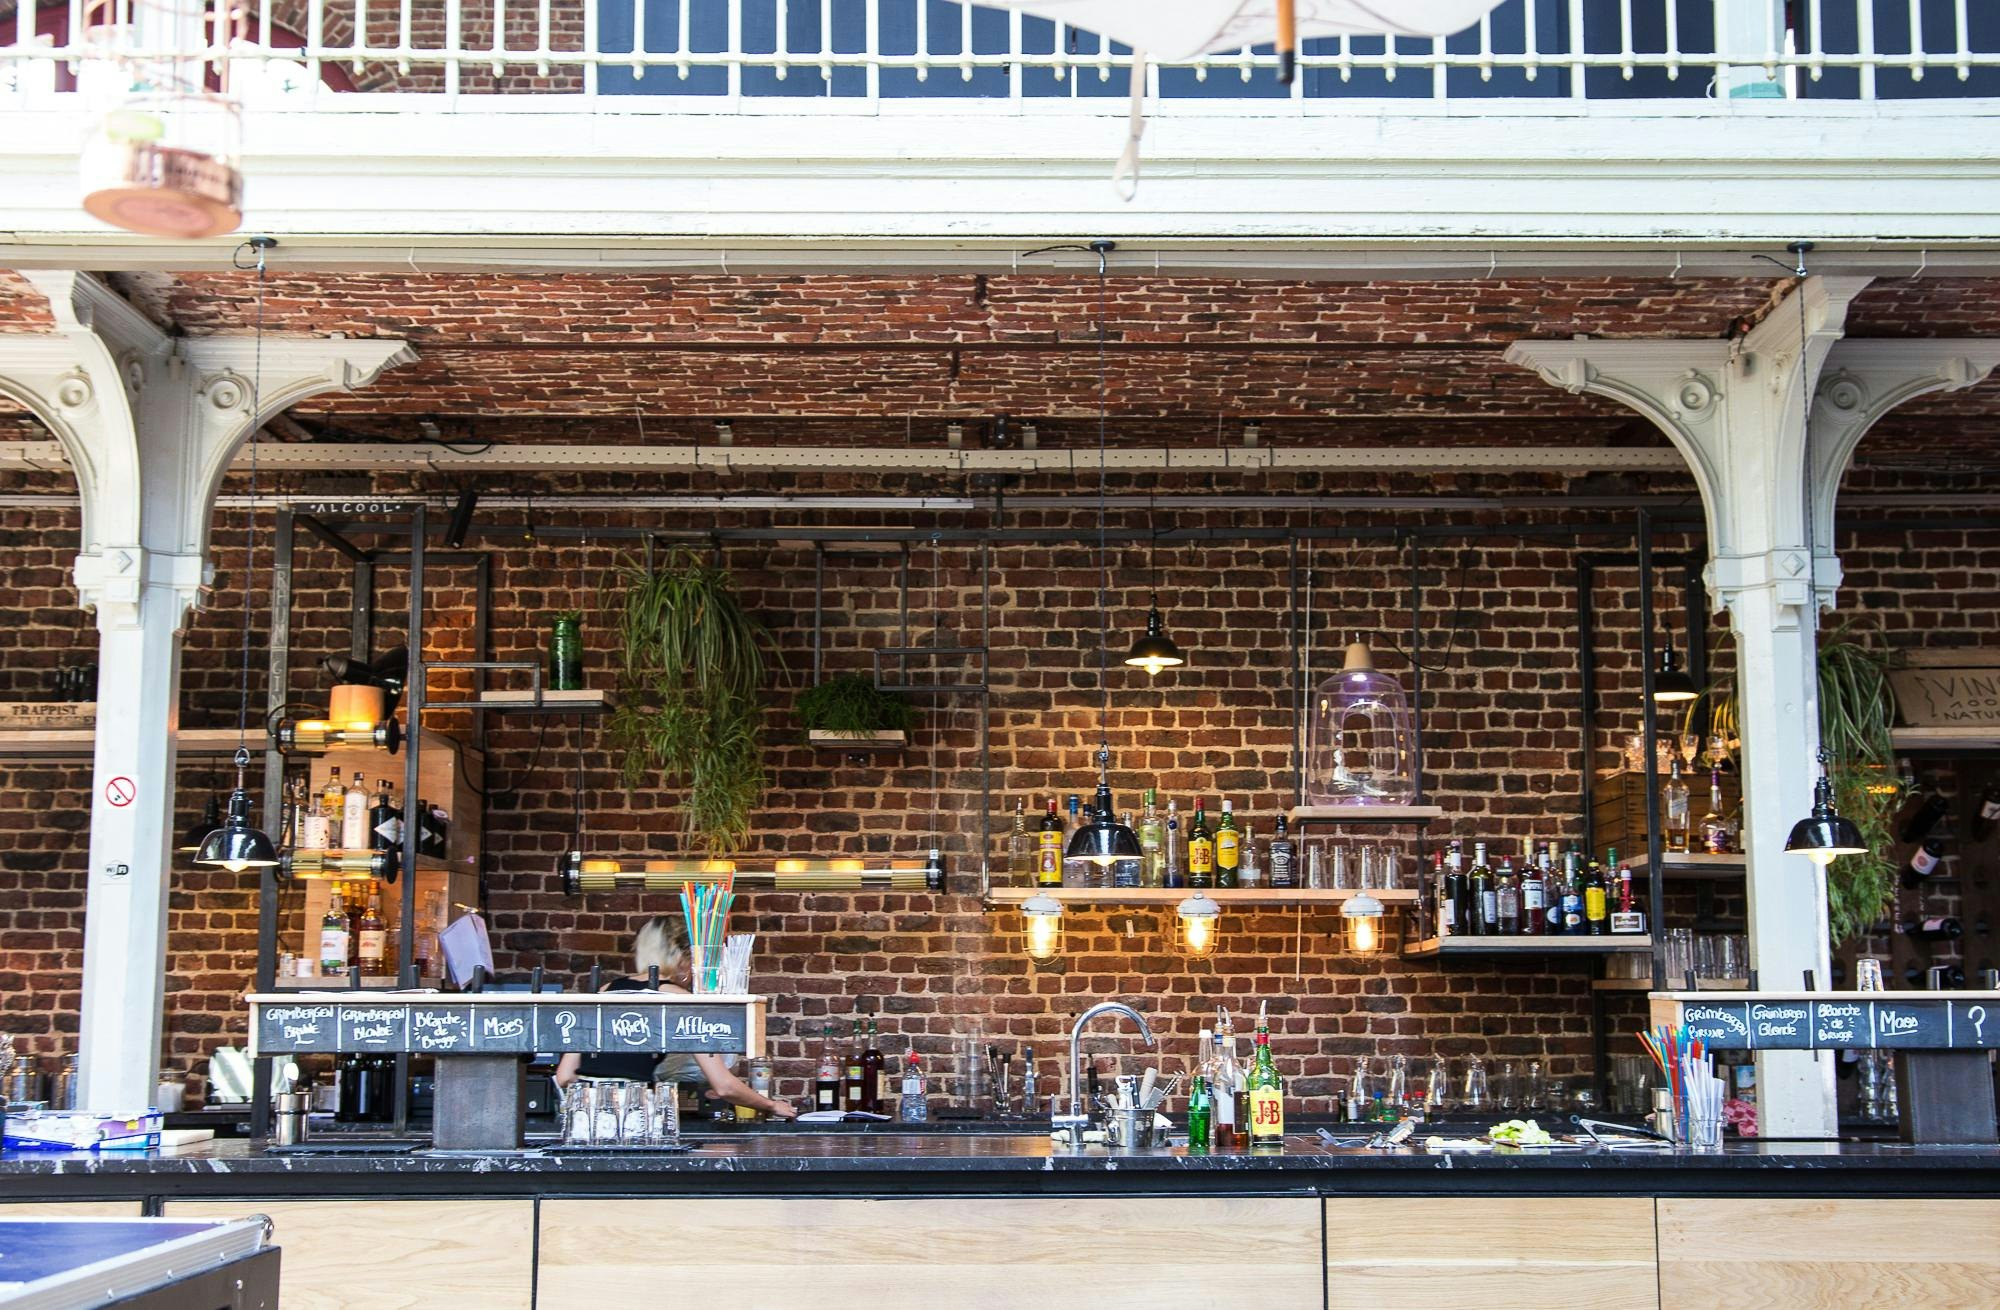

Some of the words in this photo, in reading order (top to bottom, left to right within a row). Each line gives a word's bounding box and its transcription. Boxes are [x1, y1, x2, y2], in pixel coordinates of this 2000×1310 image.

[1931, 676, 2000, 698] VIN
[11, 704, 79, 716] TRAPPIST
[484, 1016, 524, 1036] Maes
[555, 1010, 577, 1044] ?
[675, 1015, 733, 1037] Affligem
[1967, 1005, 1986, 1045] ?
